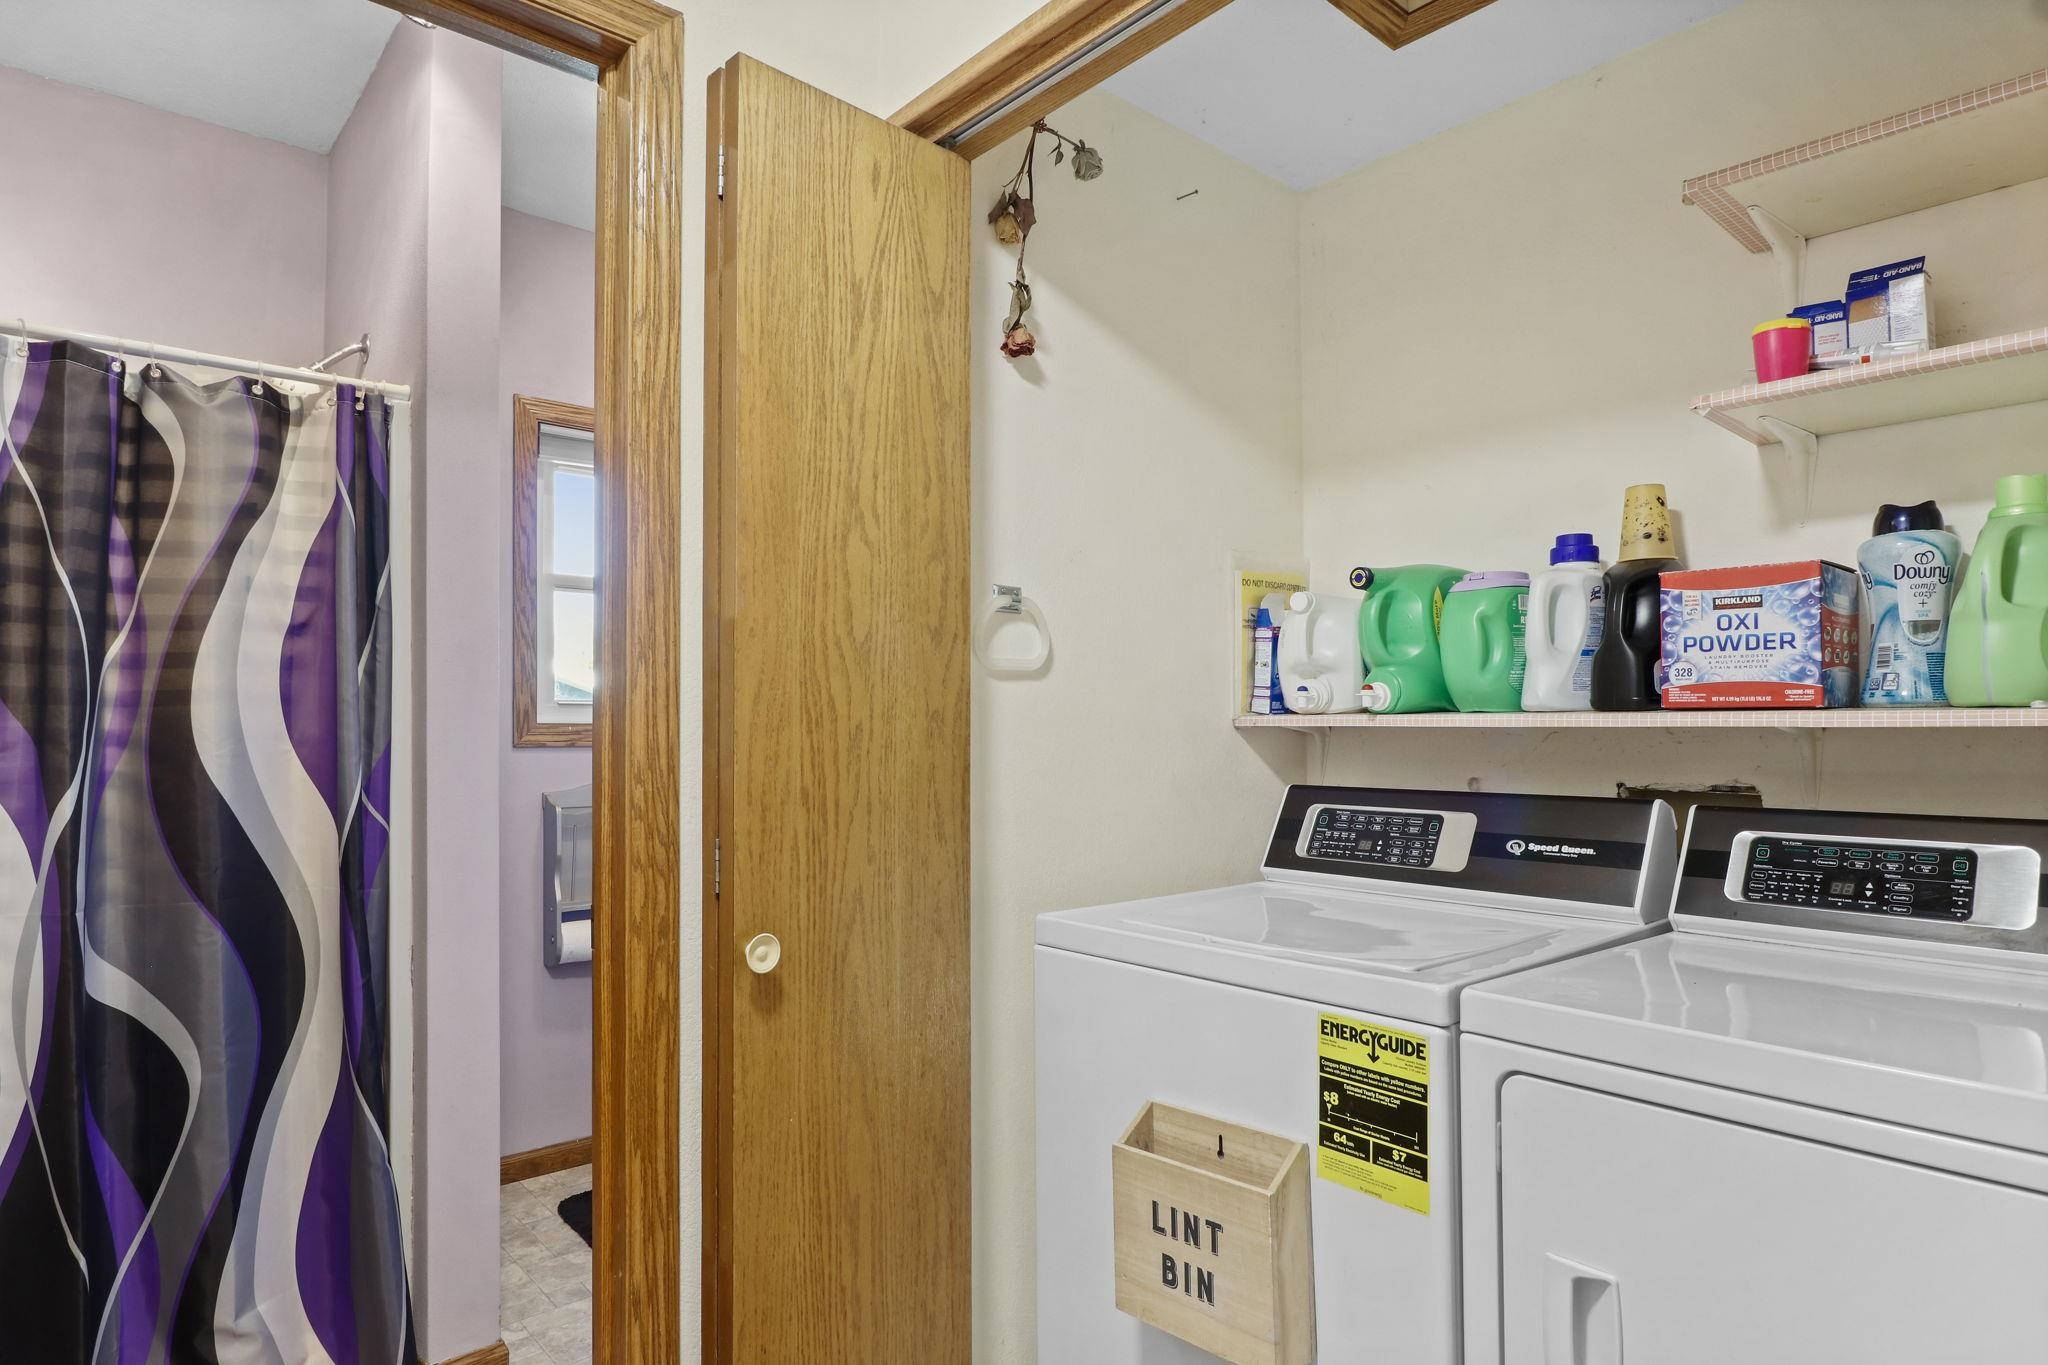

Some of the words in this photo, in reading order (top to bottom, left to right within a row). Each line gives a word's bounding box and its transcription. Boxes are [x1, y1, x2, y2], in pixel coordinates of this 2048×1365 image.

[1883, 262, 1923, 278] BAND-AID
[1893, 563, 1951, 585] Downy
[1242, 578, 1251, 587] DO
[1252, 579, 1264, 588] NOT
[1909, 581, 1937, 591] comfy
[1715, 595, 1761, 606] KIRKLAND
[1716, 612, 1759, 632] OXI
[1683, 631, 1798, 653] POWDER
[1674, 667, 1693, 678] 328
[1527, 842, 1559, 853] Speed
[1321, 1019, 1427, 1062] ENERGYGUIDE
[1323, 1090, 1339, 1105] $8
[1333, 1132, 1347, 1144] 64
[1392, 1149, 1407, 1162] $7
[1152, 1200, 1224, 1256] LINT
[1162, 1253, 1215, 1306] BIN
